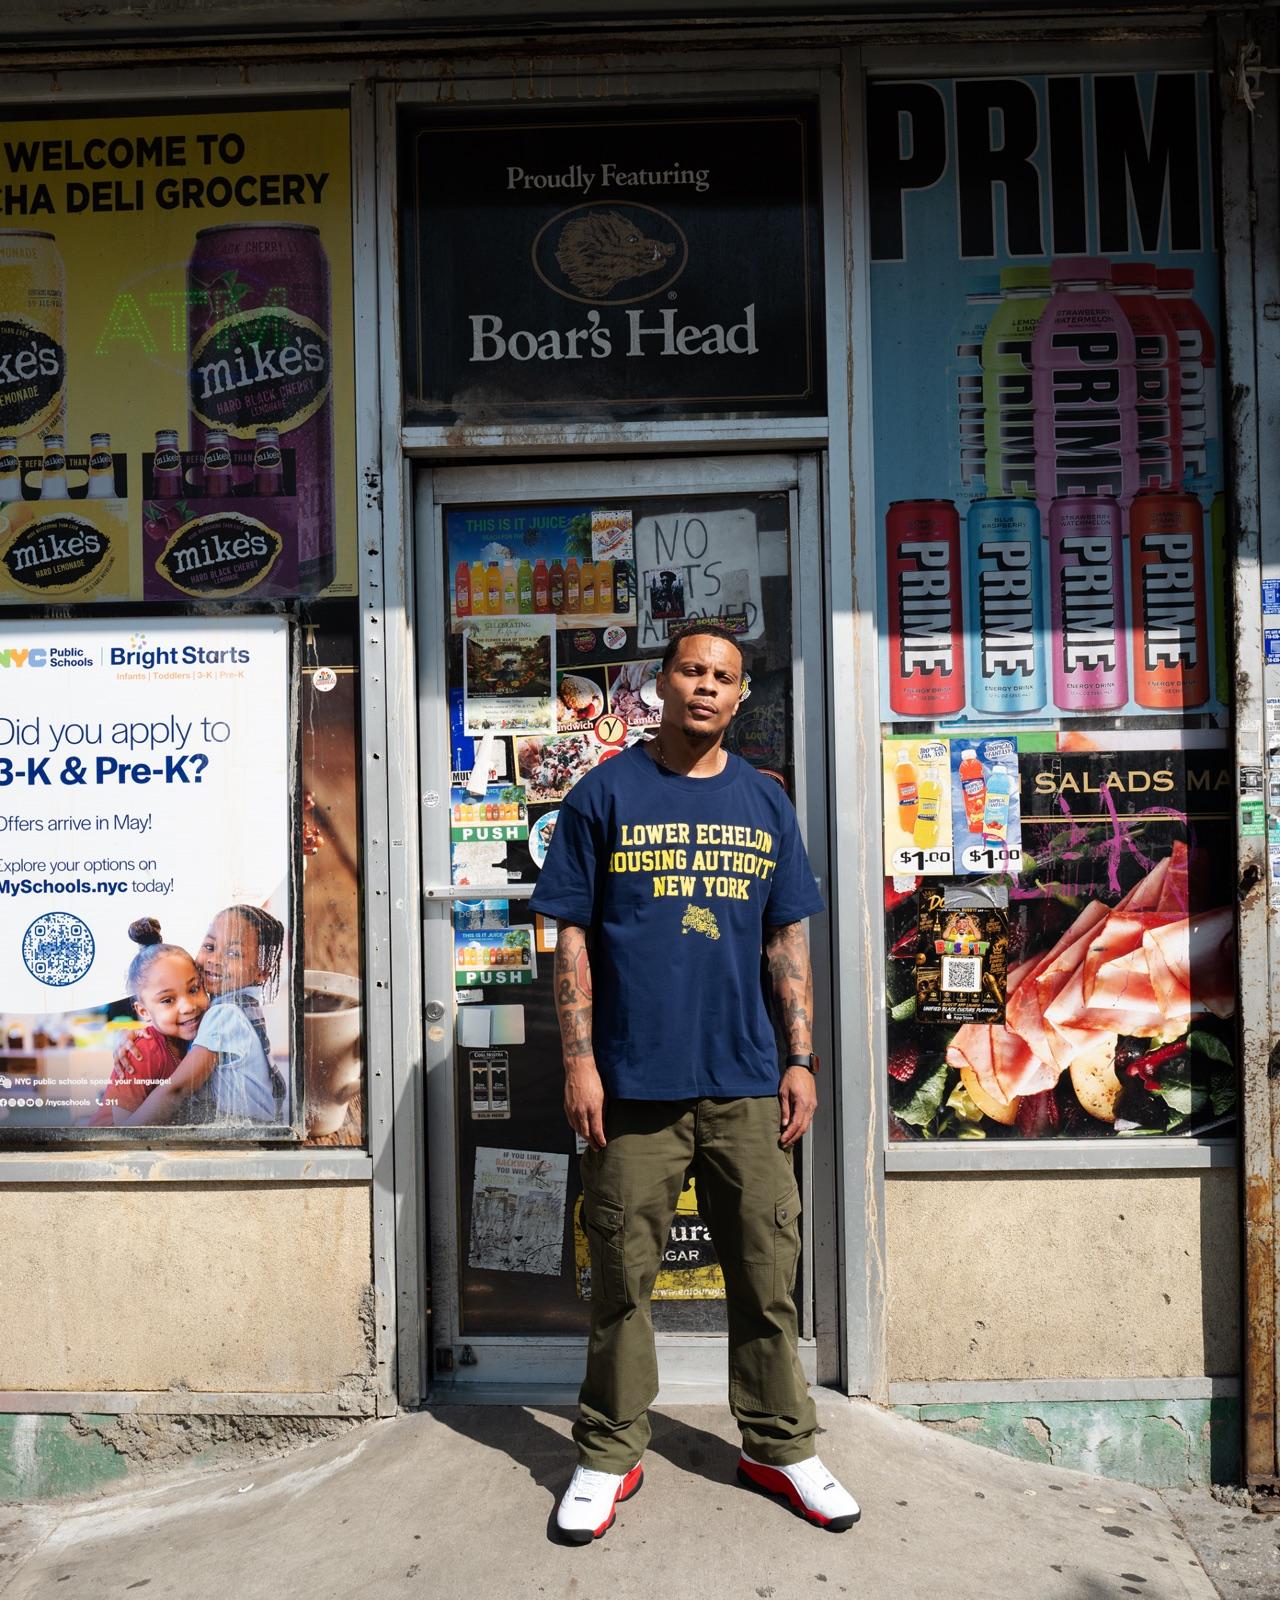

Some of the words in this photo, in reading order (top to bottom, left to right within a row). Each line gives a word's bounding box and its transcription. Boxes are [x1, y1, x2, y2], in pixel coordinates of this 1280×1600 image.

[4, 135, 186, 173] WELCOME
[197, 133, 245, 165] TO
[506, 165, 596, 195] Proudly
[600, 162, 710, 192] Featuring
[868, 74, 1214, 262] PRIM
[0, 183, 55, 216] HA
[66, 179, 144, 214] DELI
[155, 173, 330, 211] GROCERY
[95, 285, 289, 355] ATM
[468, 309, 612, 362] Boar's
[625, 303, 759, 358] Head
[198, 336, 324, 400] mike's
[216, 400, 242, 416] HARD
[244, 390, 276, 410] BLACK
[279, 377, 316, 399] CHERRY
[1050, 331, 1124, 498] PRIME
[466, 519, 495, 533] THIS
[499, 518, 511, 531] IS
[514, 517, 526, 530] IT
[529, 516, 567, 530] JUICE
[12, 531, 101, 571] mike's
[173, 531, 269, 574] mike's
[654, 518, 708, 565] NO
[35, 569, 52, 579] HARD
[53, 559, 86, 574] LEMONADE
[210, 567, 232, 579] BLACK
[234, 560, 260, 573] CHERRY
[898, 541, 954, 679] PRIME
[978, 541, 1035, 679] PRIME
[1060, 535, 1116, 674] PRIME
[1141, 534, 1199, 673] PRIME
[50, 648, 84, 658] Public
[50, 657, 94, 667] Schools
[110, 647, 179, 669] Bright
[182, 646, 250, 665] Starts
[117, 673, 146, 681] Infants
[153, 672, 191, 680] Toddlers
[197, 671, 213, 679] 3-K
[219, 671, 245, 679] Pre-K
[49, 723, 102, 752] you
[112, 714, 192, 750] apply
[200, 717, 230, 743] to
[557, 720, 594, 732] andwich
[0, 757, 51, 786] 3-K
[60, 756, 87, 785] &
[96, 753, 209, 785] Pre-K?
[1034, 769, 1175, 794] SALADS
[48, 815, 91, 830] arrive
[96, 815, 109, 830] in
[114, 813, 152, 834] May!
[462, 827, 519, 841] PUSH
[621, 823, 690, 846] LOWER
[696, 823, 773, 854] ECHELON
[50, 861, 80, 875] your
[84, 858, 135, 874] options
[139, 860, 157, 871] on
[900, 851, 951, 871] $1.00
[970, 849, 1020, 869] $1.00
[0, 879, 128, 897] MySchools.nyc
[132, 878, 174, 895] today!
[653, 875, 697, 898] NEW
[702, 876, 752, 901] YORK
[466, 971, 522, 984] PUSH
[33, 1077, 56, 1087] public
[58, 1077, 88, 1085] schools
[90, 1077, 112, 1086] speak
[115, 1079, 132, 1087] your
[134, 1076, 171, 1087] language!
[45, 1098, 91, 1107] /nycschools
[105, 1098, 119, 1106] 311
[511, 1152, 525, 1160] YOU
